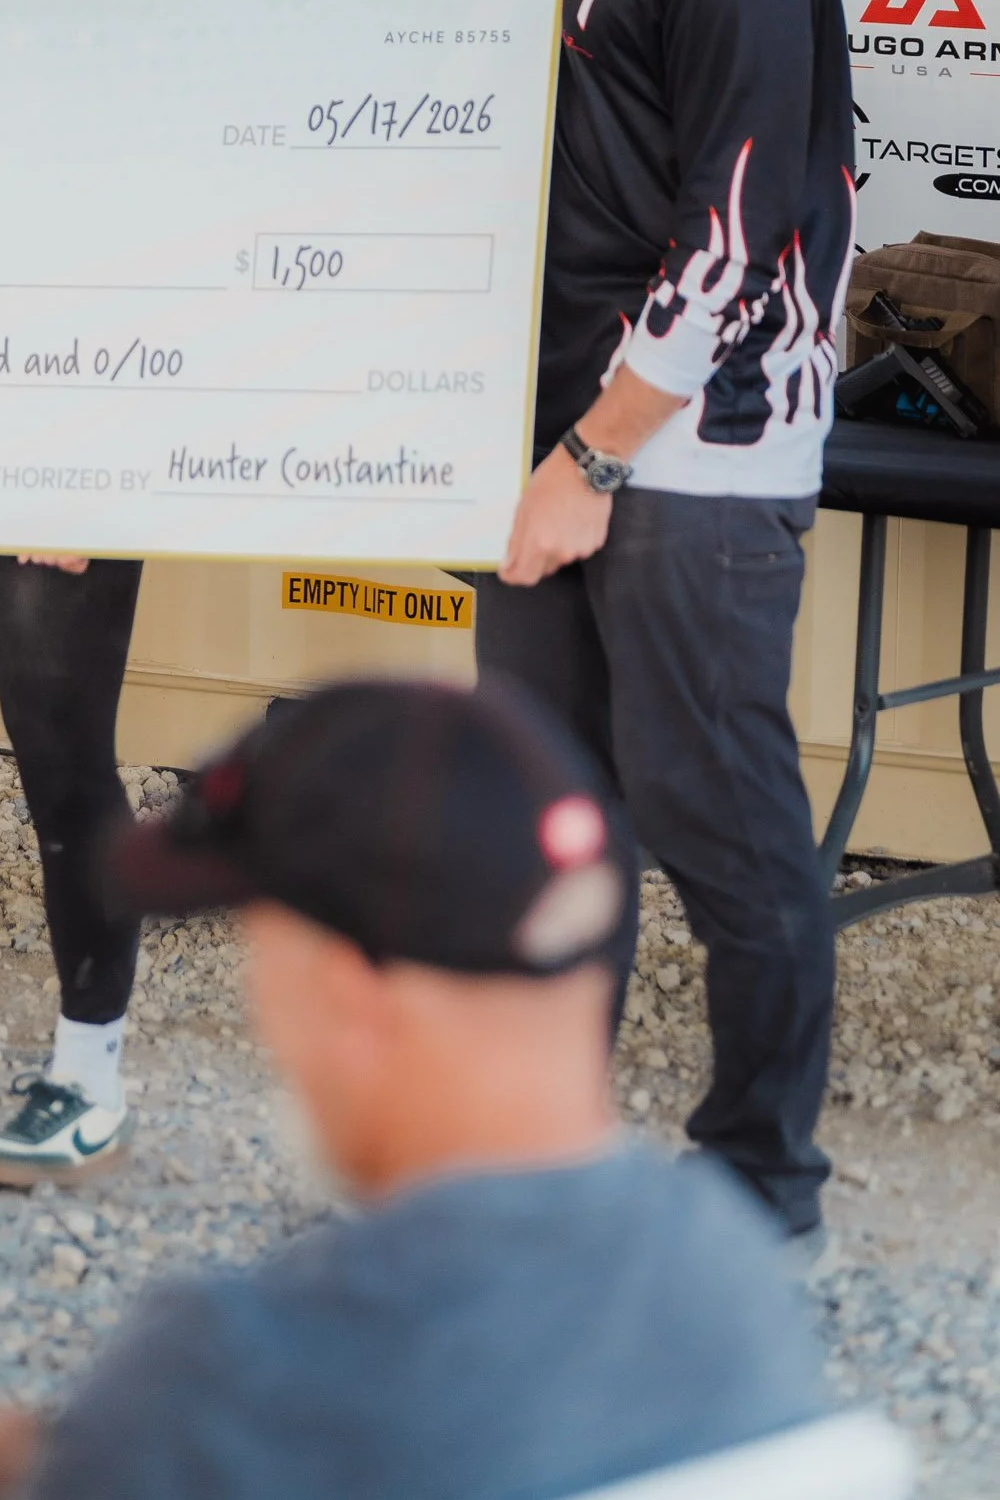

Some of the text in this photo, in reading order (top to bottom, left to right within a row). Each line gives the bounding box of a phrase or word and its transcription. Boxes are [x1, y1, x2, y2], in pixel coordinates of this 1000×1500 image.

[384, 30, 512, 44] AYCHE 85755
[222, 93, 495, 146] DATE 05/17/2026
[862, 138, 1000, 169] TARGET
[272, 245, 343, 290] 1,500
[24, 338, 80, 375] and
[94, 338, 182, 381] 0/100
[367, 370, 485, 393] DOLLARS
[120, 469, 151, 491] BY
[169, 442, 268, 483] Hunter
[281, 446, 454, 488] Constantine
[289, 577, 465, 622] EMPTY LIFT ONLY
